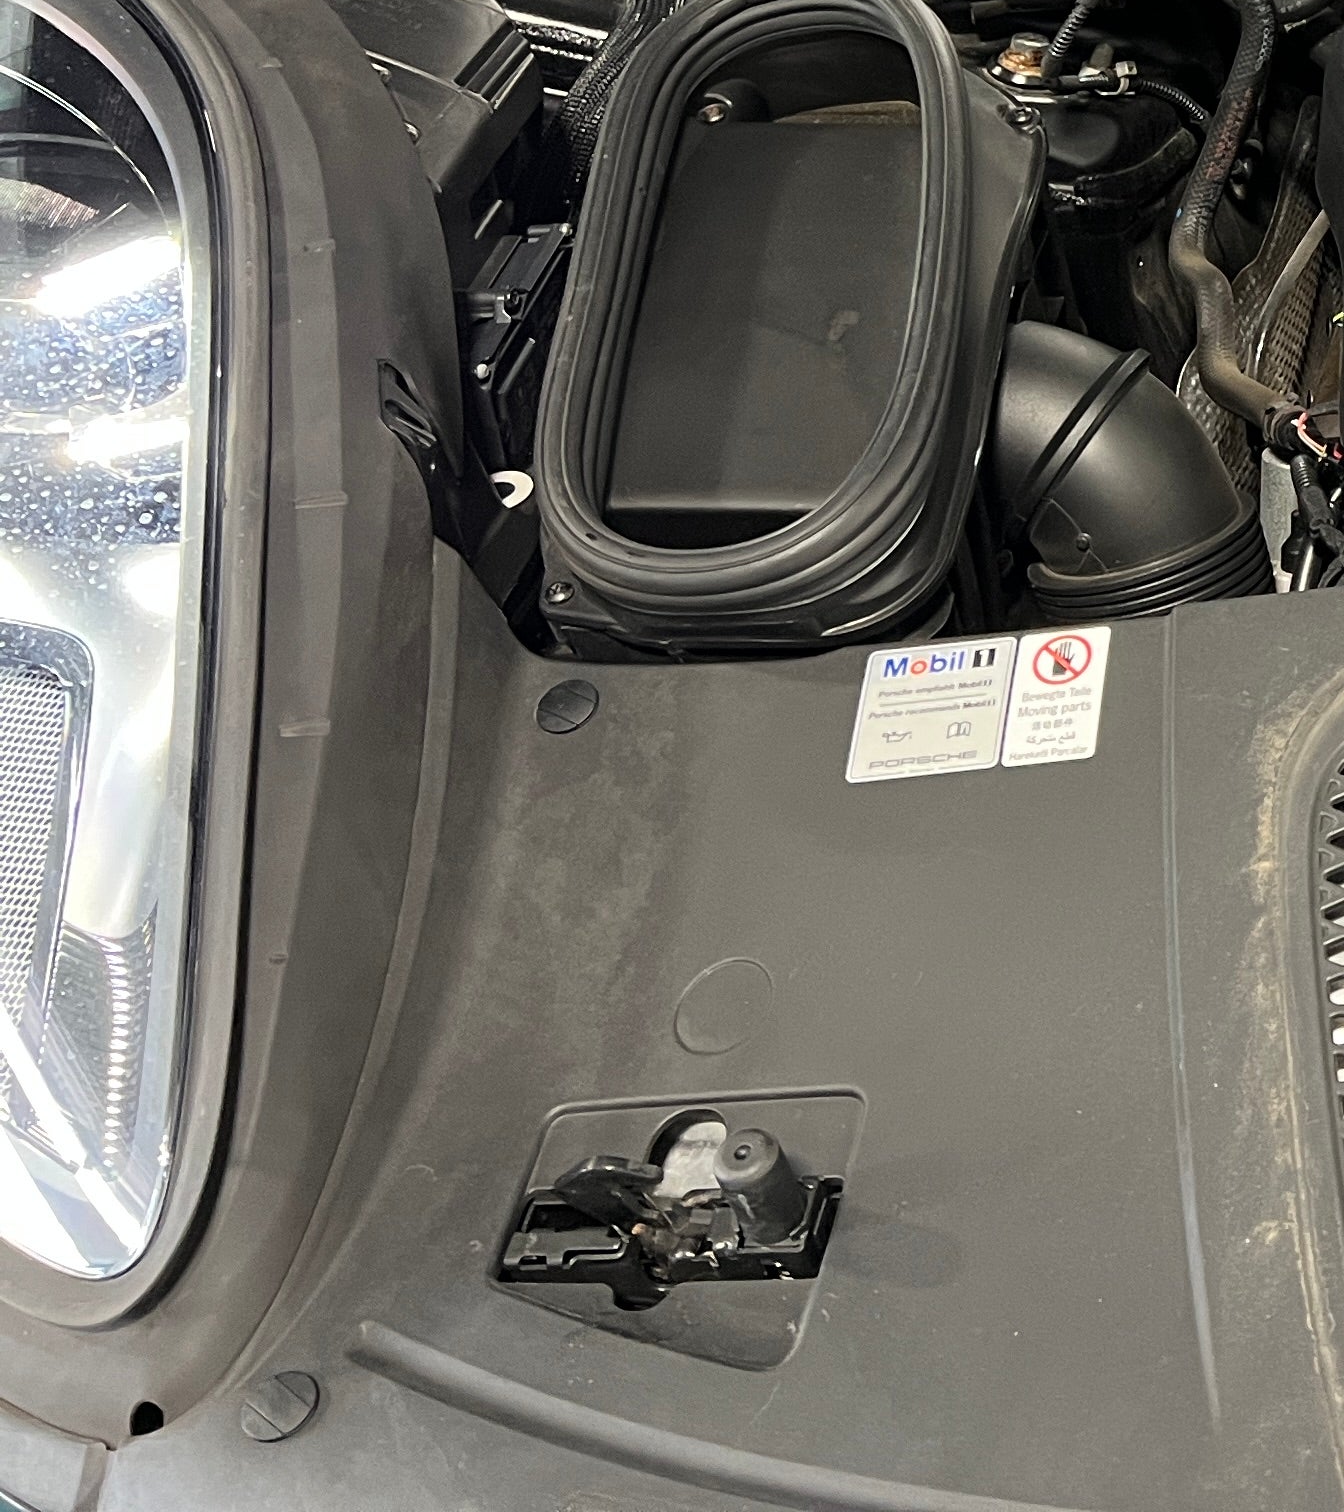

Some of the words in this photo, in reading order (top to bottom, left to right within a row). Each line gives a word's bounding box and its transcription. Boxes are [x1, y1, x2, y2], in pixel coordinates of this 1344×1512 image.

[883, 651, 966, 678] Mobil
[973, 648, 996, 668] 1
[1017, 704, 1058, 717] Moving
[1061, 701, 1092, 714] parts
[868, 750, 978, 769] PORSCHE
